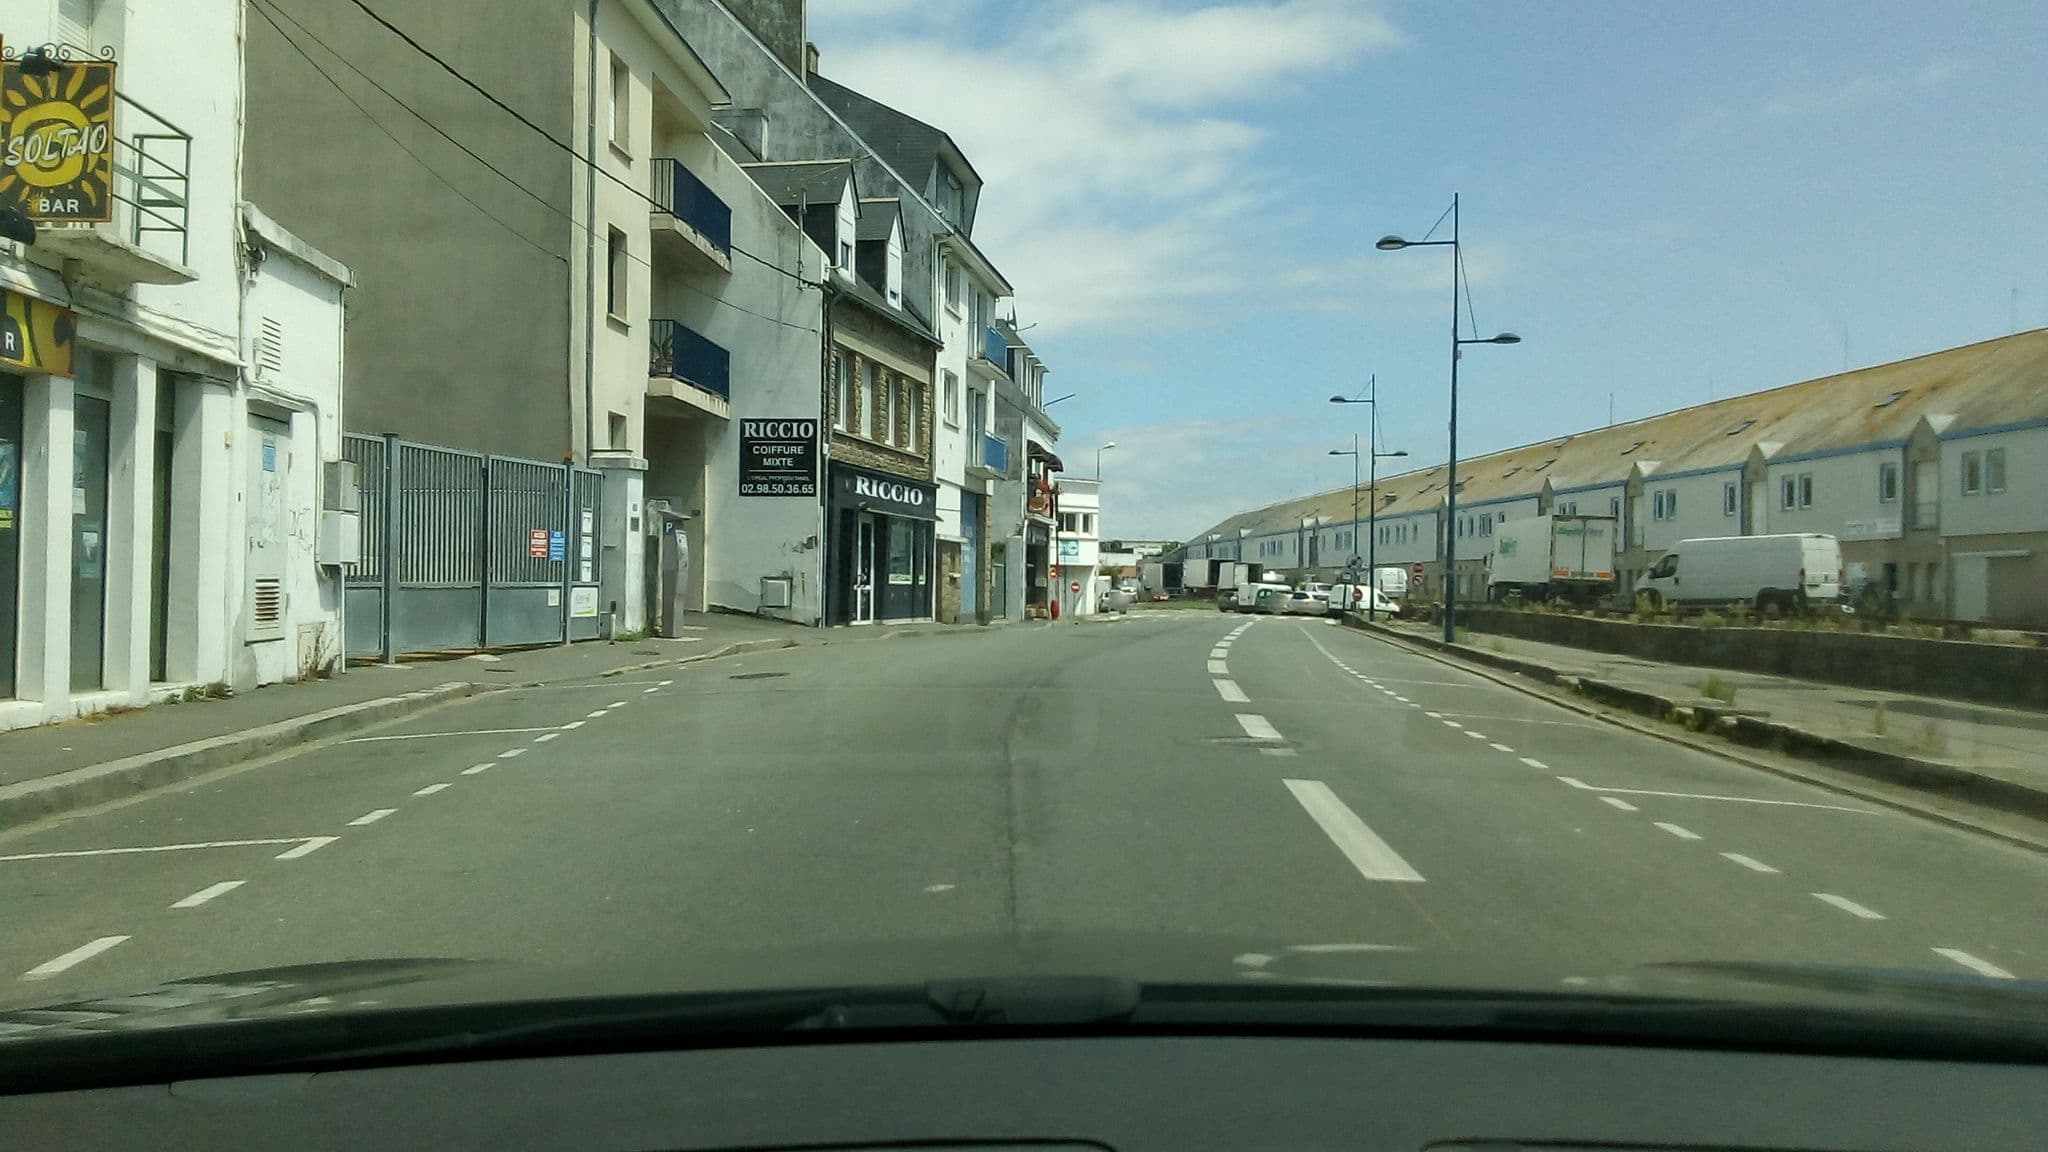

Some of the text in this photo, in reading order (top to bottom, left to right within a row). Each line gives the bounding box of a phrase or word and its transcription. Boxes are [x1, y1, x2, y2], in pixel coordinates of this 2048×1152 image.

[4, 124, 107, 166] SOLTAO
[39, 198, 80, 213] BAR
[744, 422, 814, 438] RICCIO
[752, 445, 805, 456] COIFFURE
[762, 457, 794, 467] MIXTE
[741, 483, 814, 494] 02.98.50.36.65
[855, 475, 924, 506] RICCIO
[666, 522, 673, 533] P
